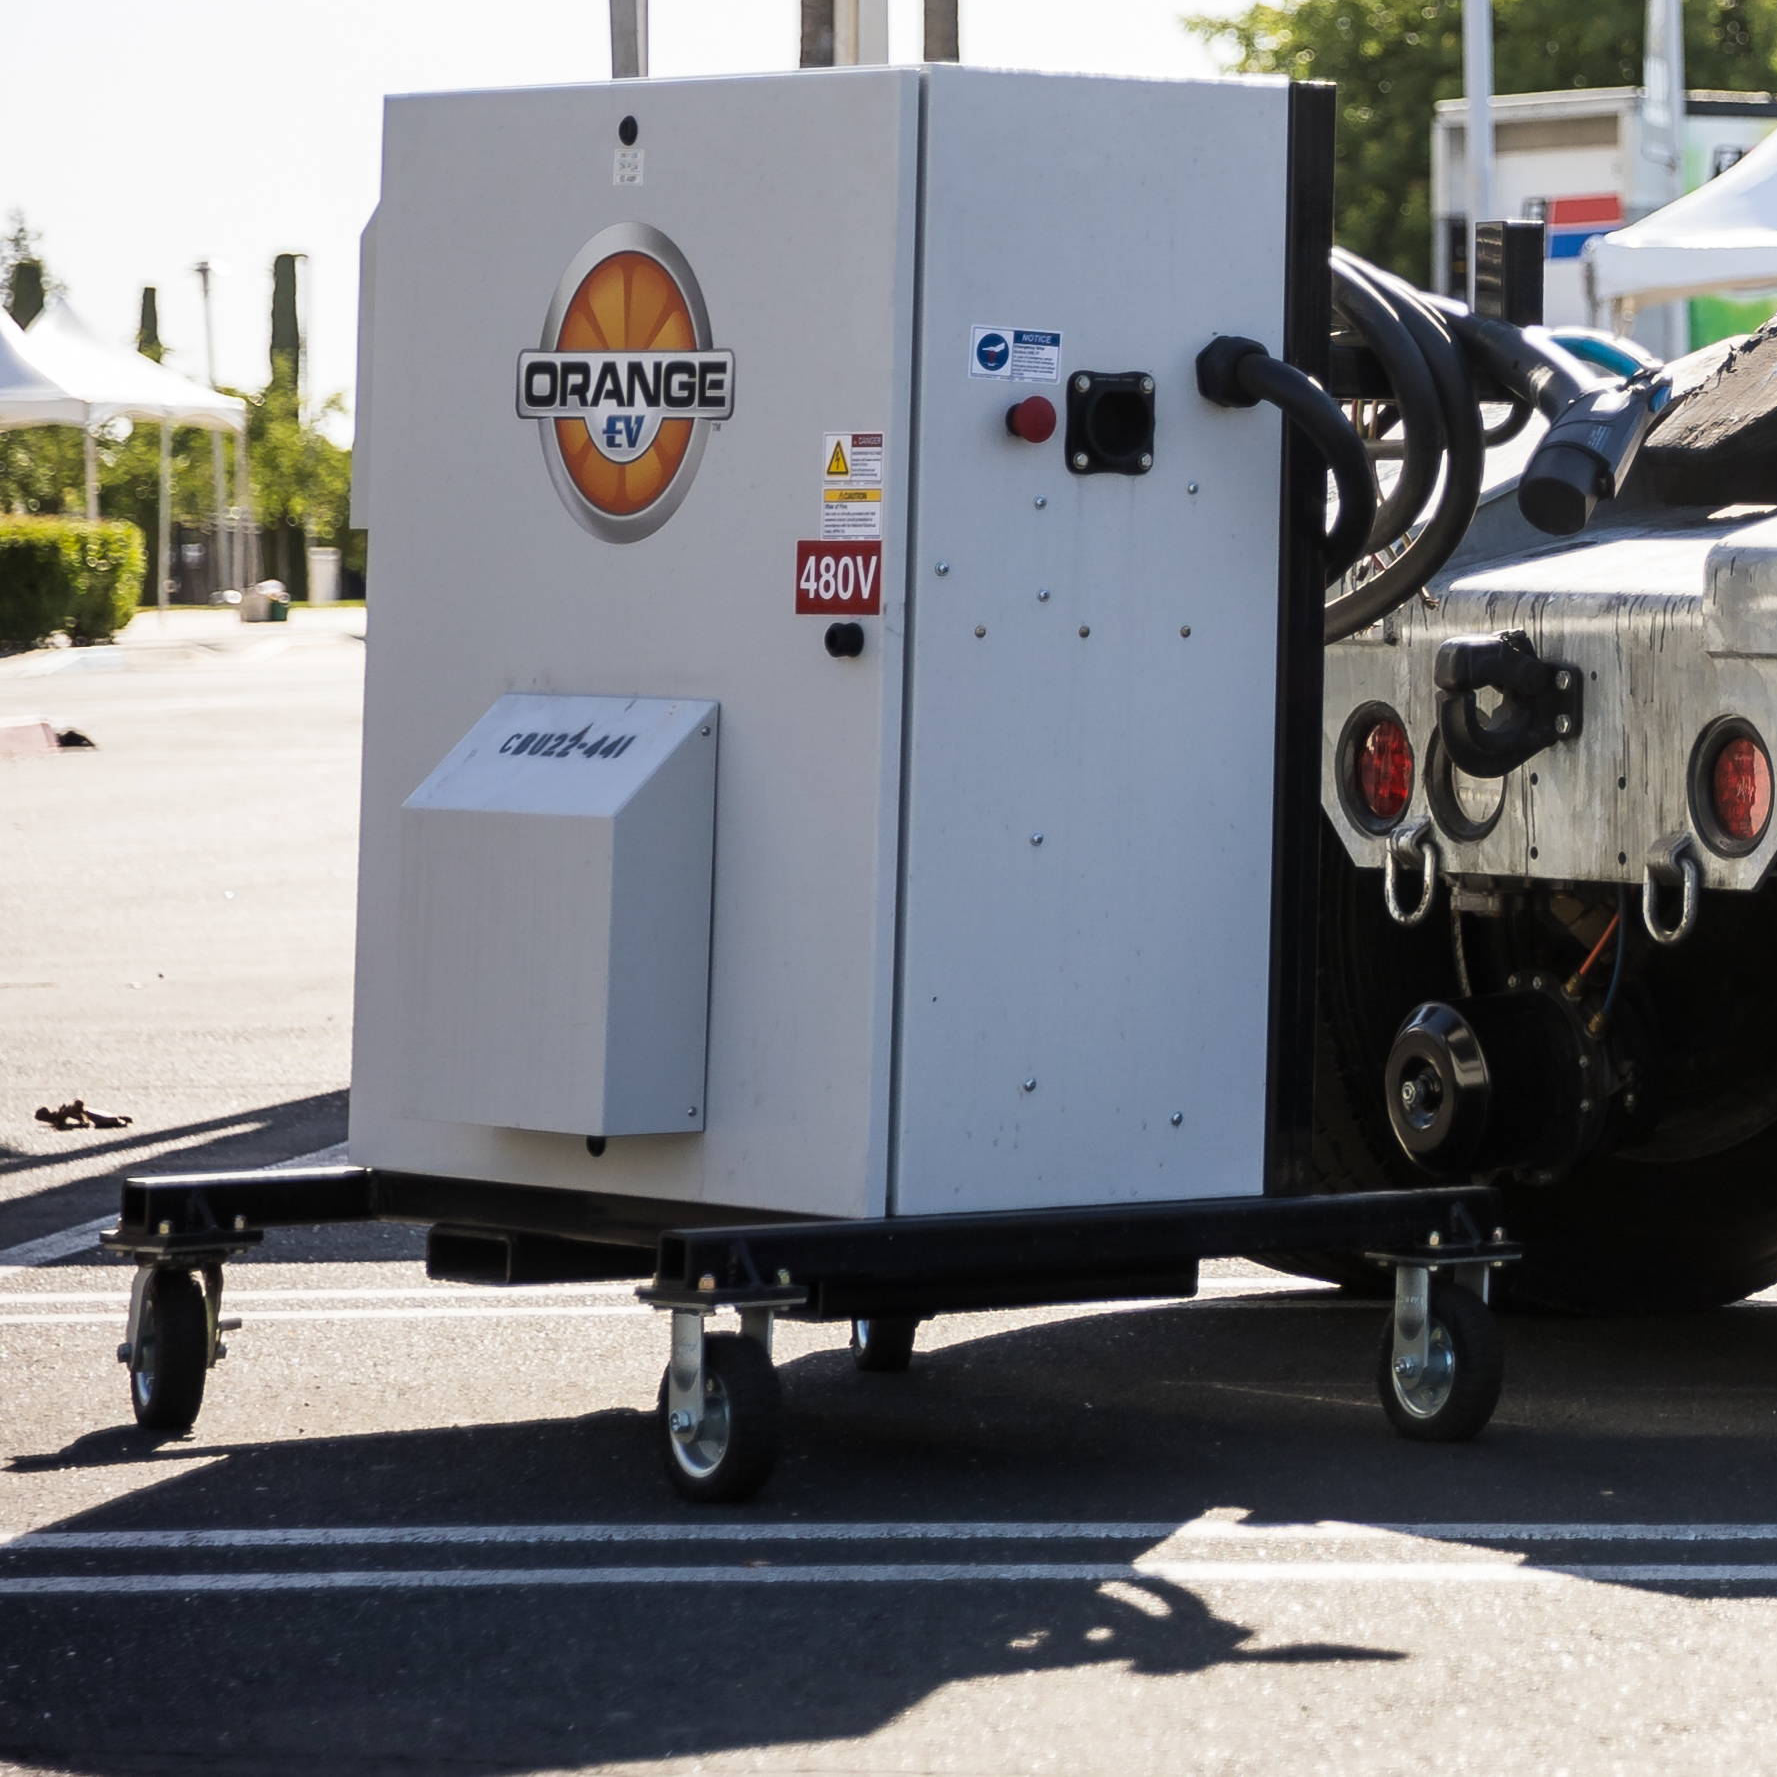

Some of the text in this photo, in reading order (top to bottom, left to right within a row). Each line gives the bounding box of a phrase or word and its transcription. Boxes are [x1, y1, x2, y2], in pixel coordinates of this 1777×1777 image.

[1021, 333, 1053, 344] NOTICE
[524, 360, 728, 408] ORANGE
[602, 414, 646, 449] EV
[799, 555, 878, 600] 480V
